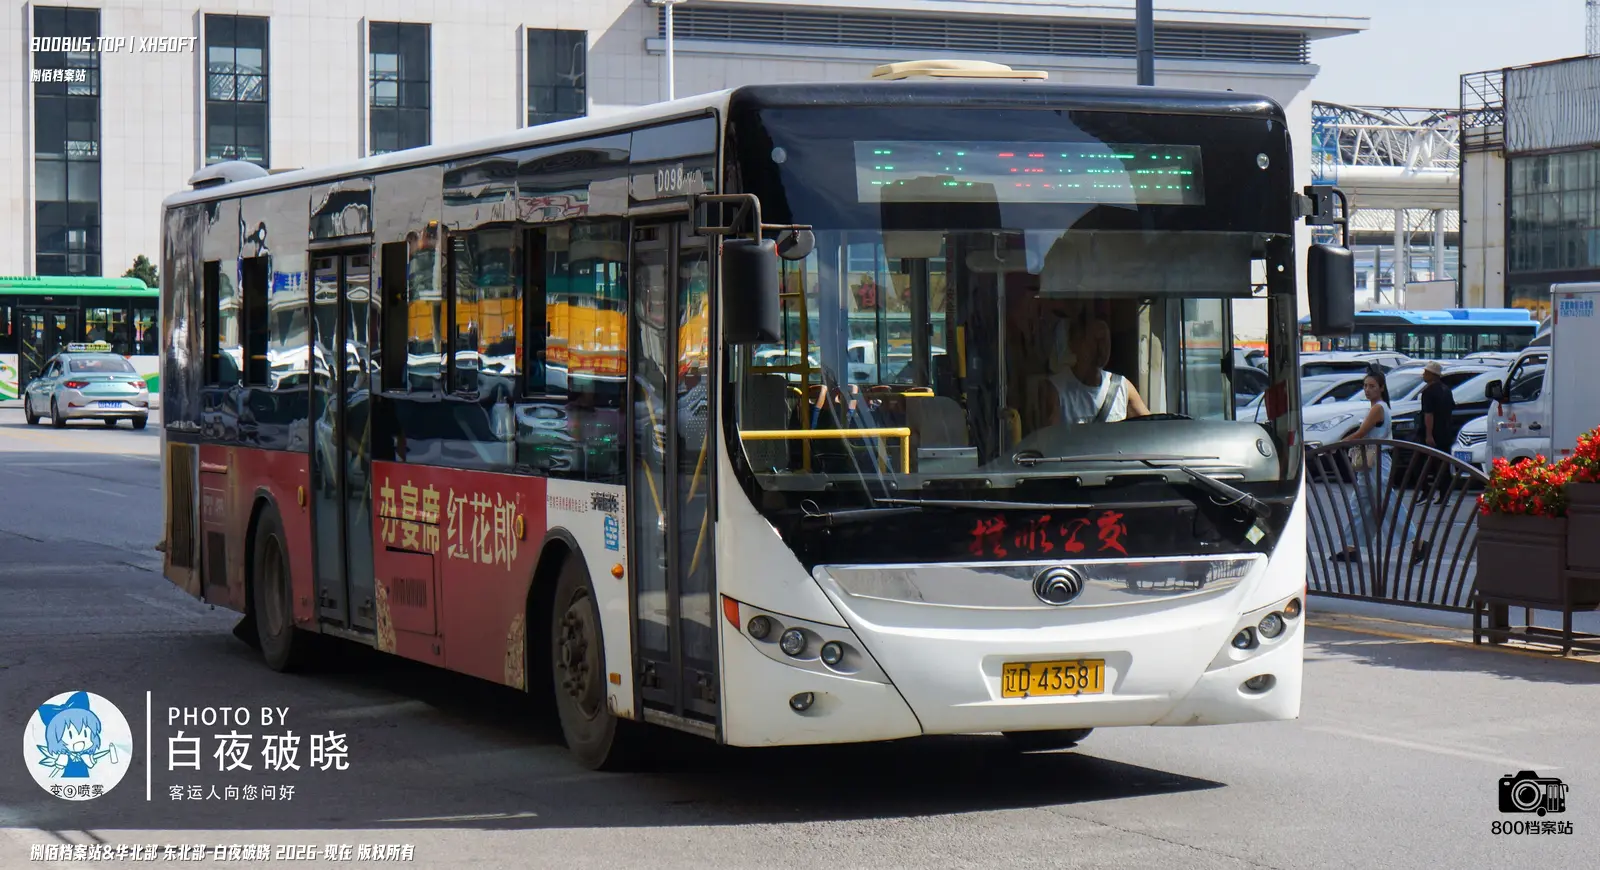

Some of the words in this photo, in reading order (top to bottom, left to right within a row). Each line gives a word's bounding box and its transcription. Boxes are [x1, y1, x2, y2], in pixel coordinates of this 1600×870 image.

[657, 167, 683, 192] D098
[380, 476, 441, 554] 办宴席
[446, 487, 518, 572] 红花郎
